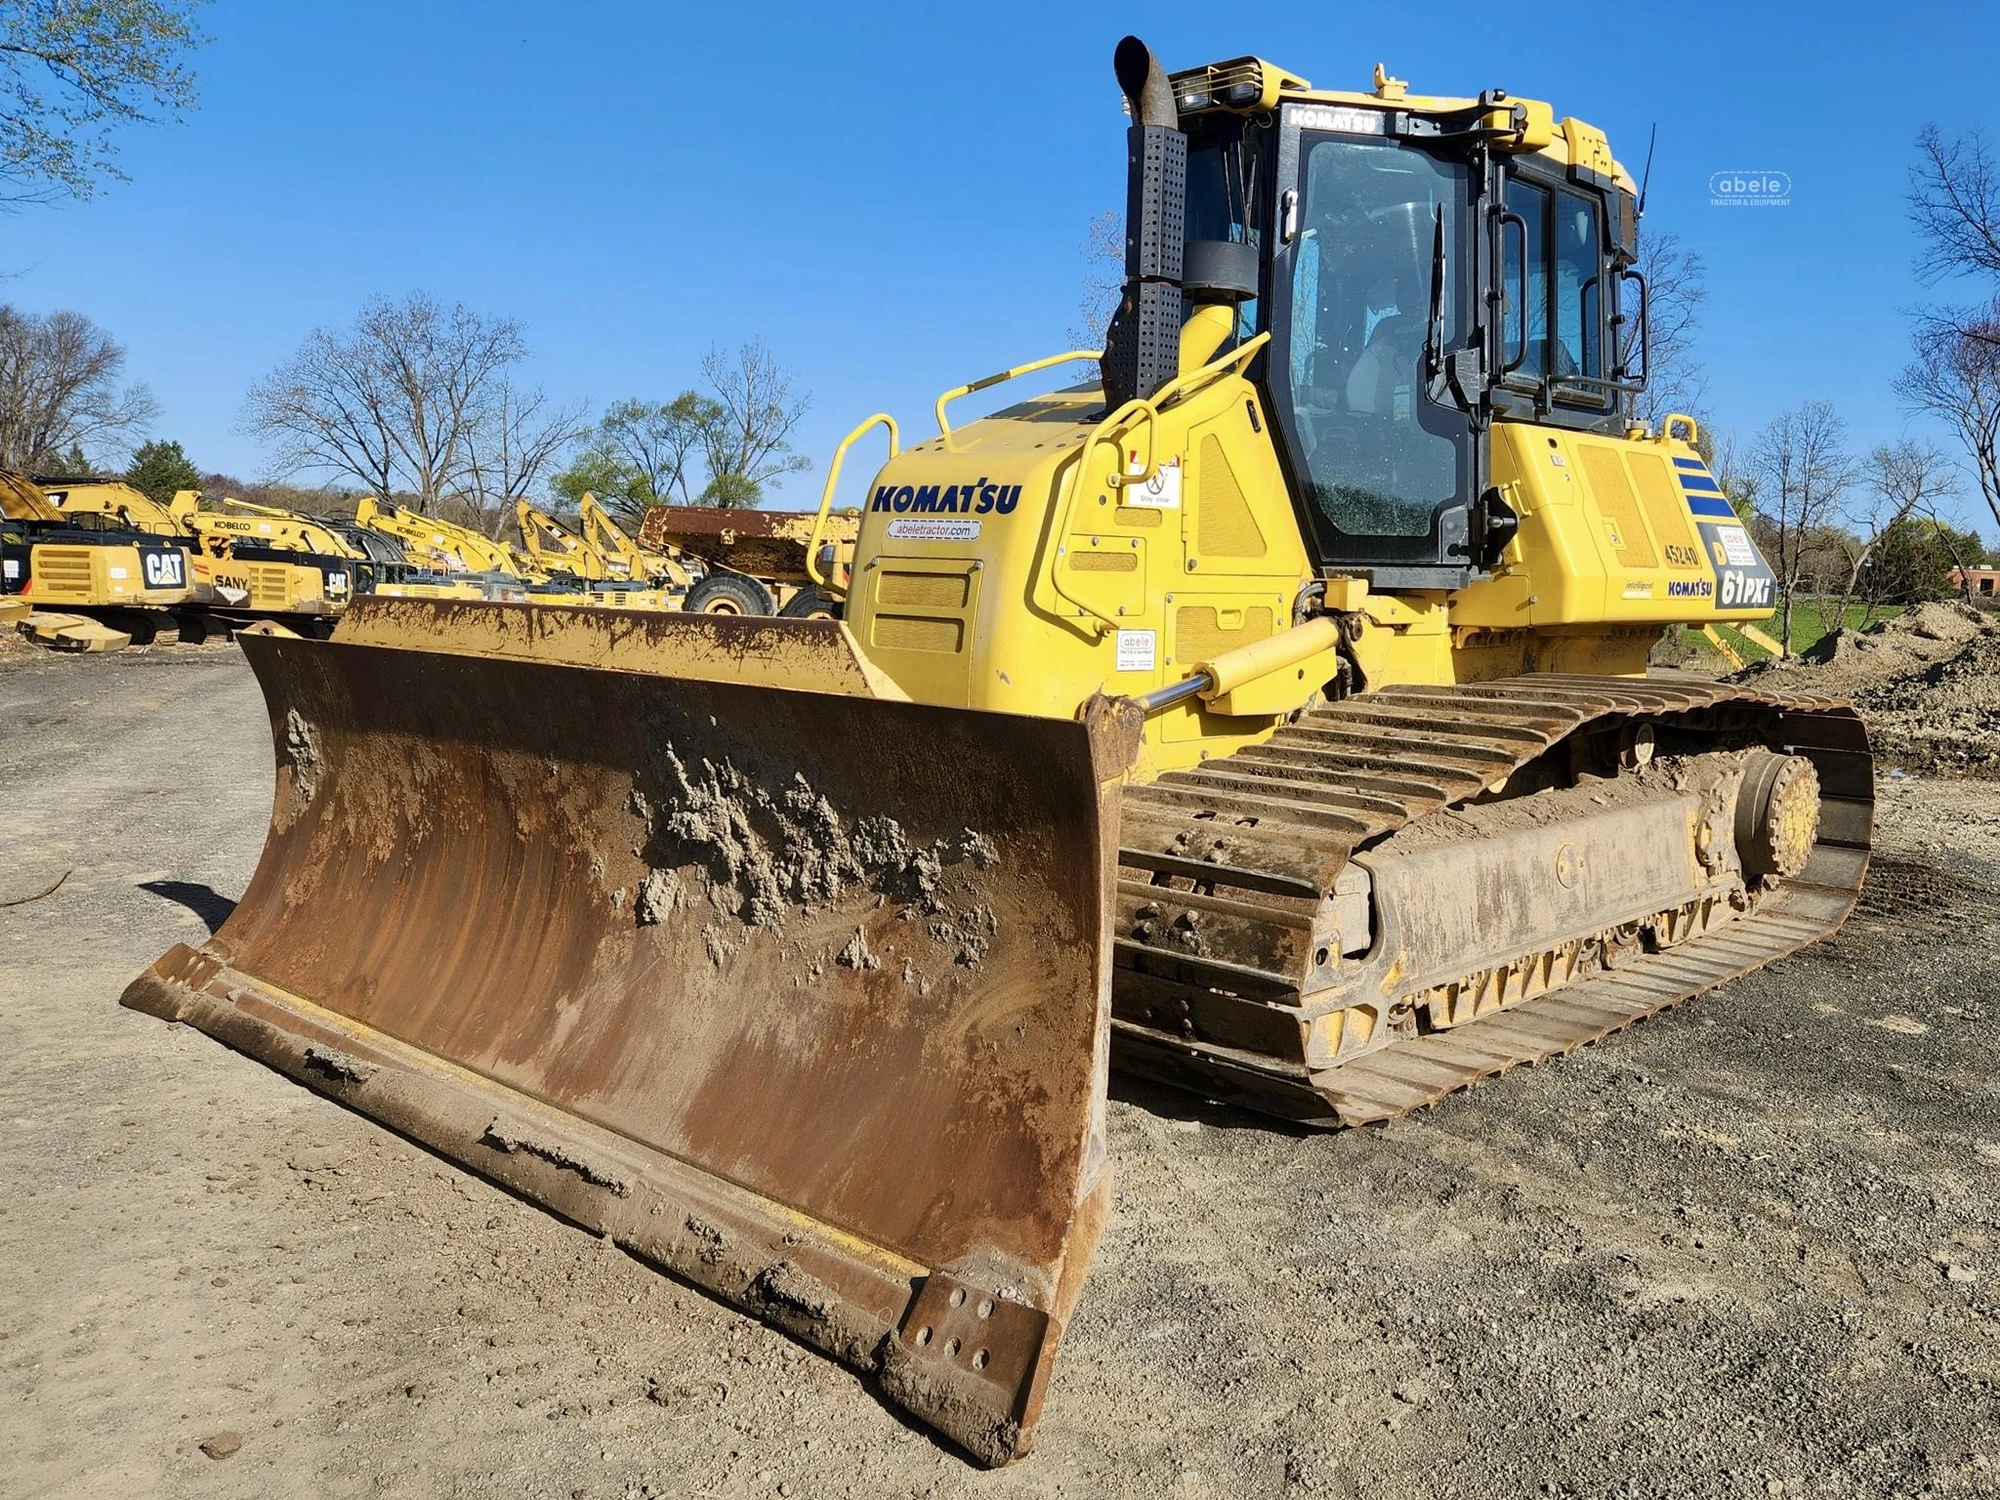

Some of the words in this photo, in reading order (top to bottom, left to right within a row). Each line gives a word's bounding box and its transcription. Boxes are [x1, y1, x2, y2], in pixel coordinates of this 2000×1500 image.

[1290, 108, 1376, 132] KOMATSU
[47, 494, 61, 508] AT
[871, 477, 1023, 514] KOMATSU
[214, 520, 251, 531] KOBELCO
[396, 526, 426, 539] KOBELCO
[896, 524, 971, 536] abeletractor.com
[1664, 544, 1699, 566] 45240
[1712, 541, 1727, 566] D
[146, 553, 182, 585] CAT
[215, 575, 248, 590] SANY
[328, 573, 346, 594] CAT
[1668, 577, 1713, 597] KOMATSU
[1721, 569, 1771, 605] 61PXi
[1124, 636, 1150, 647] abele
